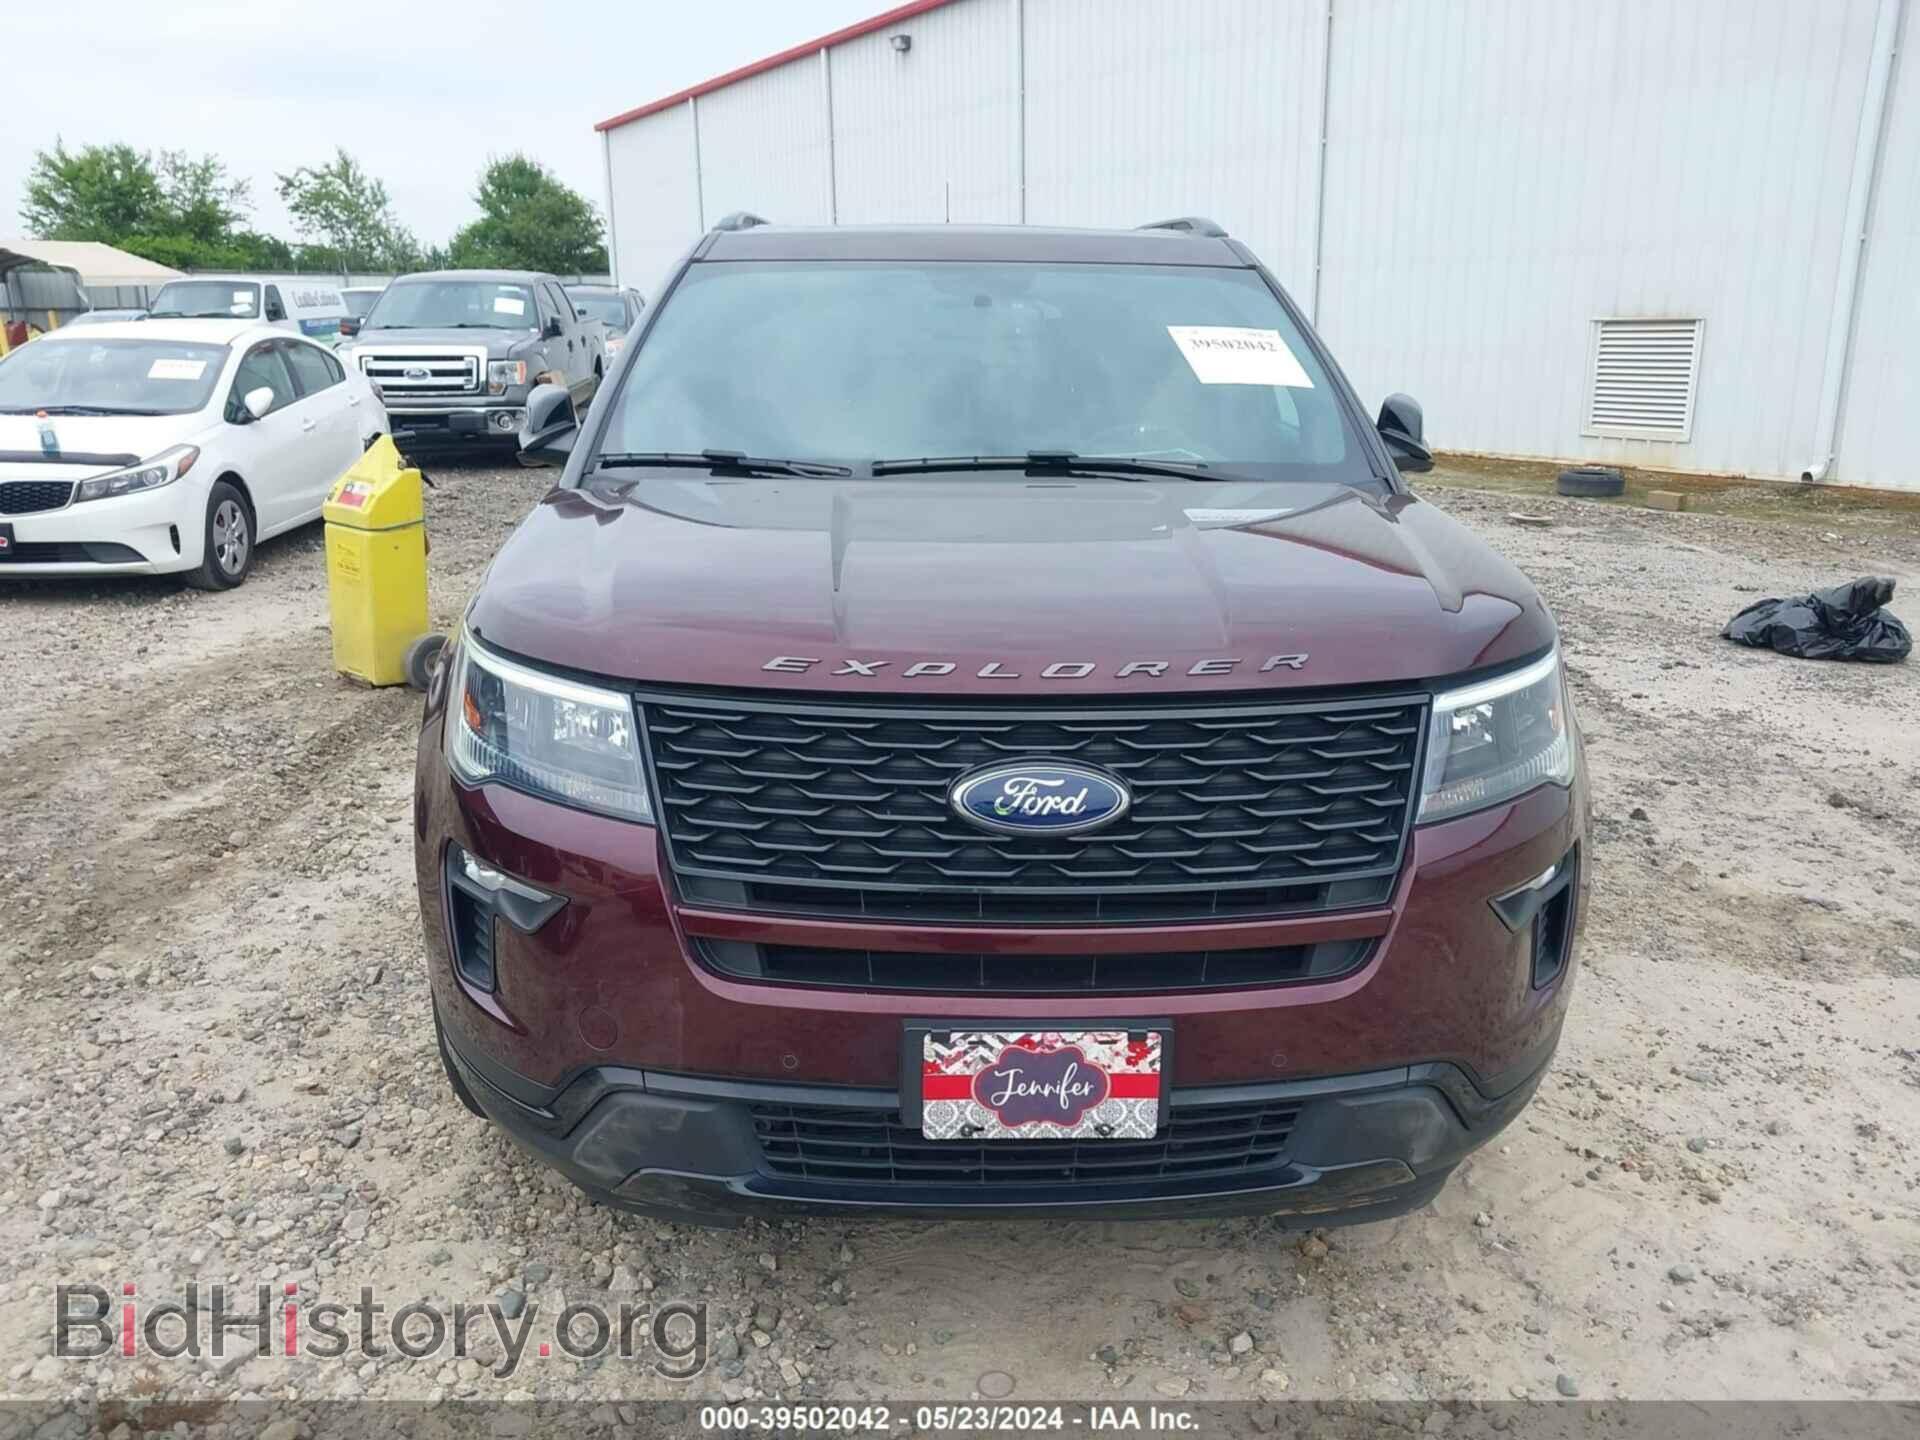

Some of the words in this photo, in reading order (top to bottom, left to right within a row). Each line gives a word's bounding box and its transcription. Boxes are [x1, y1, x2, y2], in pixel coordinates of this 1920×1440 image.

[762, 653, 1309, 679] EXPLORER
[994, 777, 1088, 815] Ford
[991, 1062, 1094, 1110] Jennifer
